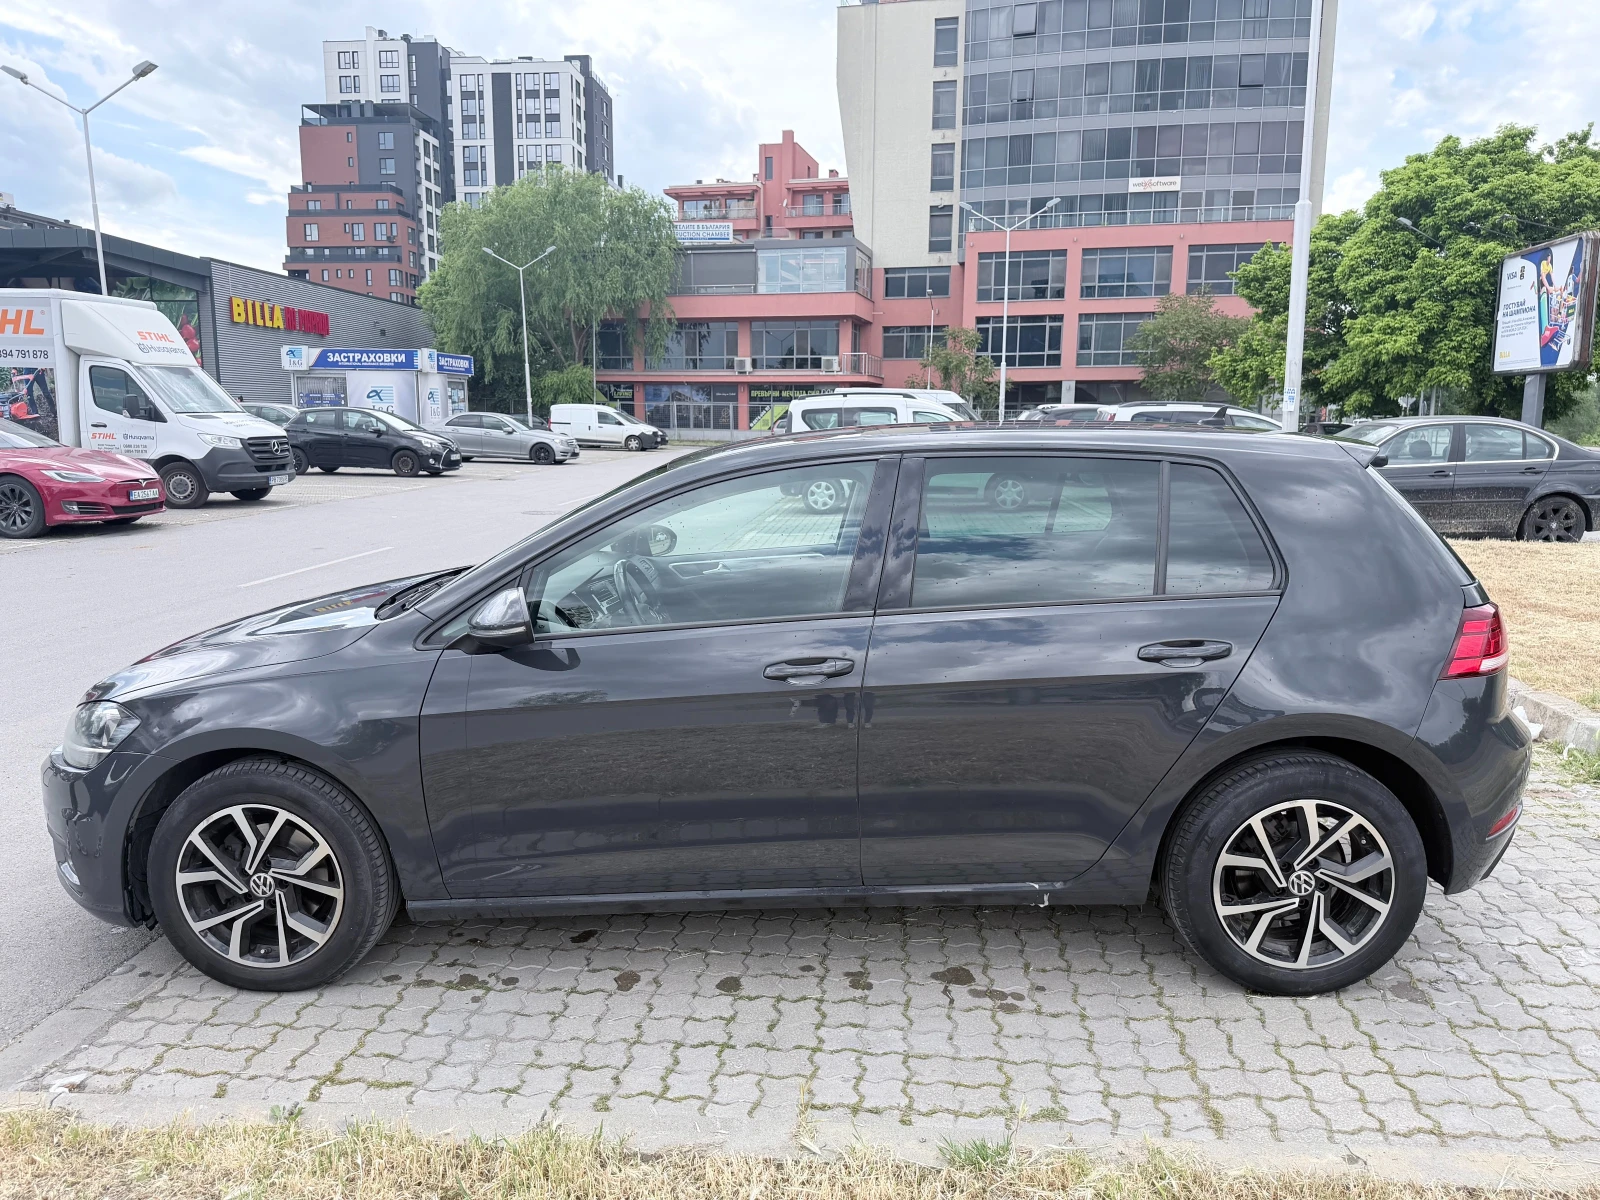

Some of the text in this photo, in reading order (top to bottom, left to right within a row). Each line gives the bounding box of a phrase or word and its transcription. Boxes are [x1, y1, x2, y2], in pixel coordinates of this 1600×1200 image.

[1507, 271, 1517, 280] VISA
[229, 295, 285, 329] BILLA
[136, 330, 175, 343] STIHL
[15, 349, 31, 359] 791
[32, 349, 49, 359] 878
[326, 353, 406, 363] ЗАСТРАХОВКИ
[438, 356, 470, 369] ЗАСТРАХОВКИ
[91, 432, 117, 440] STIHL
